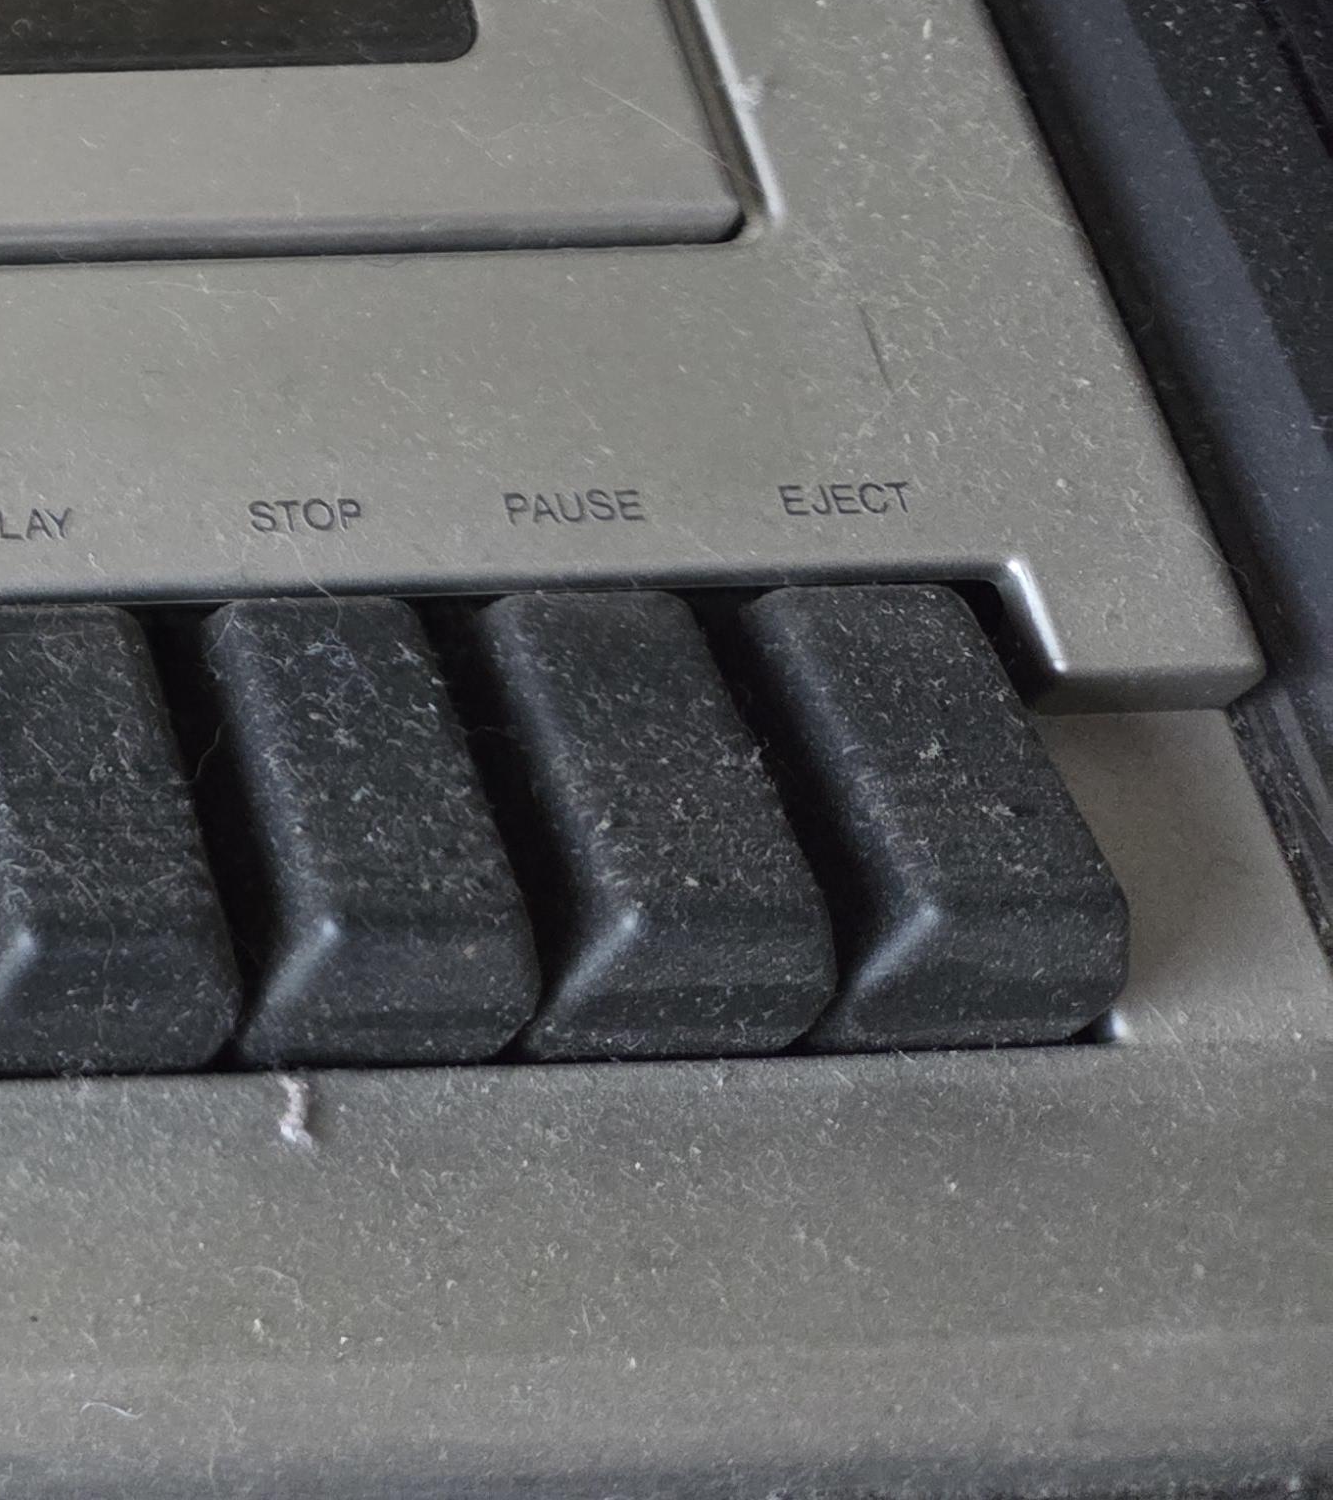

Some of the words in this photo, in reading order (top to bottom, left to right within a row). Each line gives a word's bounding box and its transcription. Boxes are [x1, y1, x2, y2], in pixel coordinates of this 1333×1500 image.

[248, 498, 364, 534] STOP
[505, 487, 645, 524] PAUSE
[780, 481, 912, 517] EJECT
